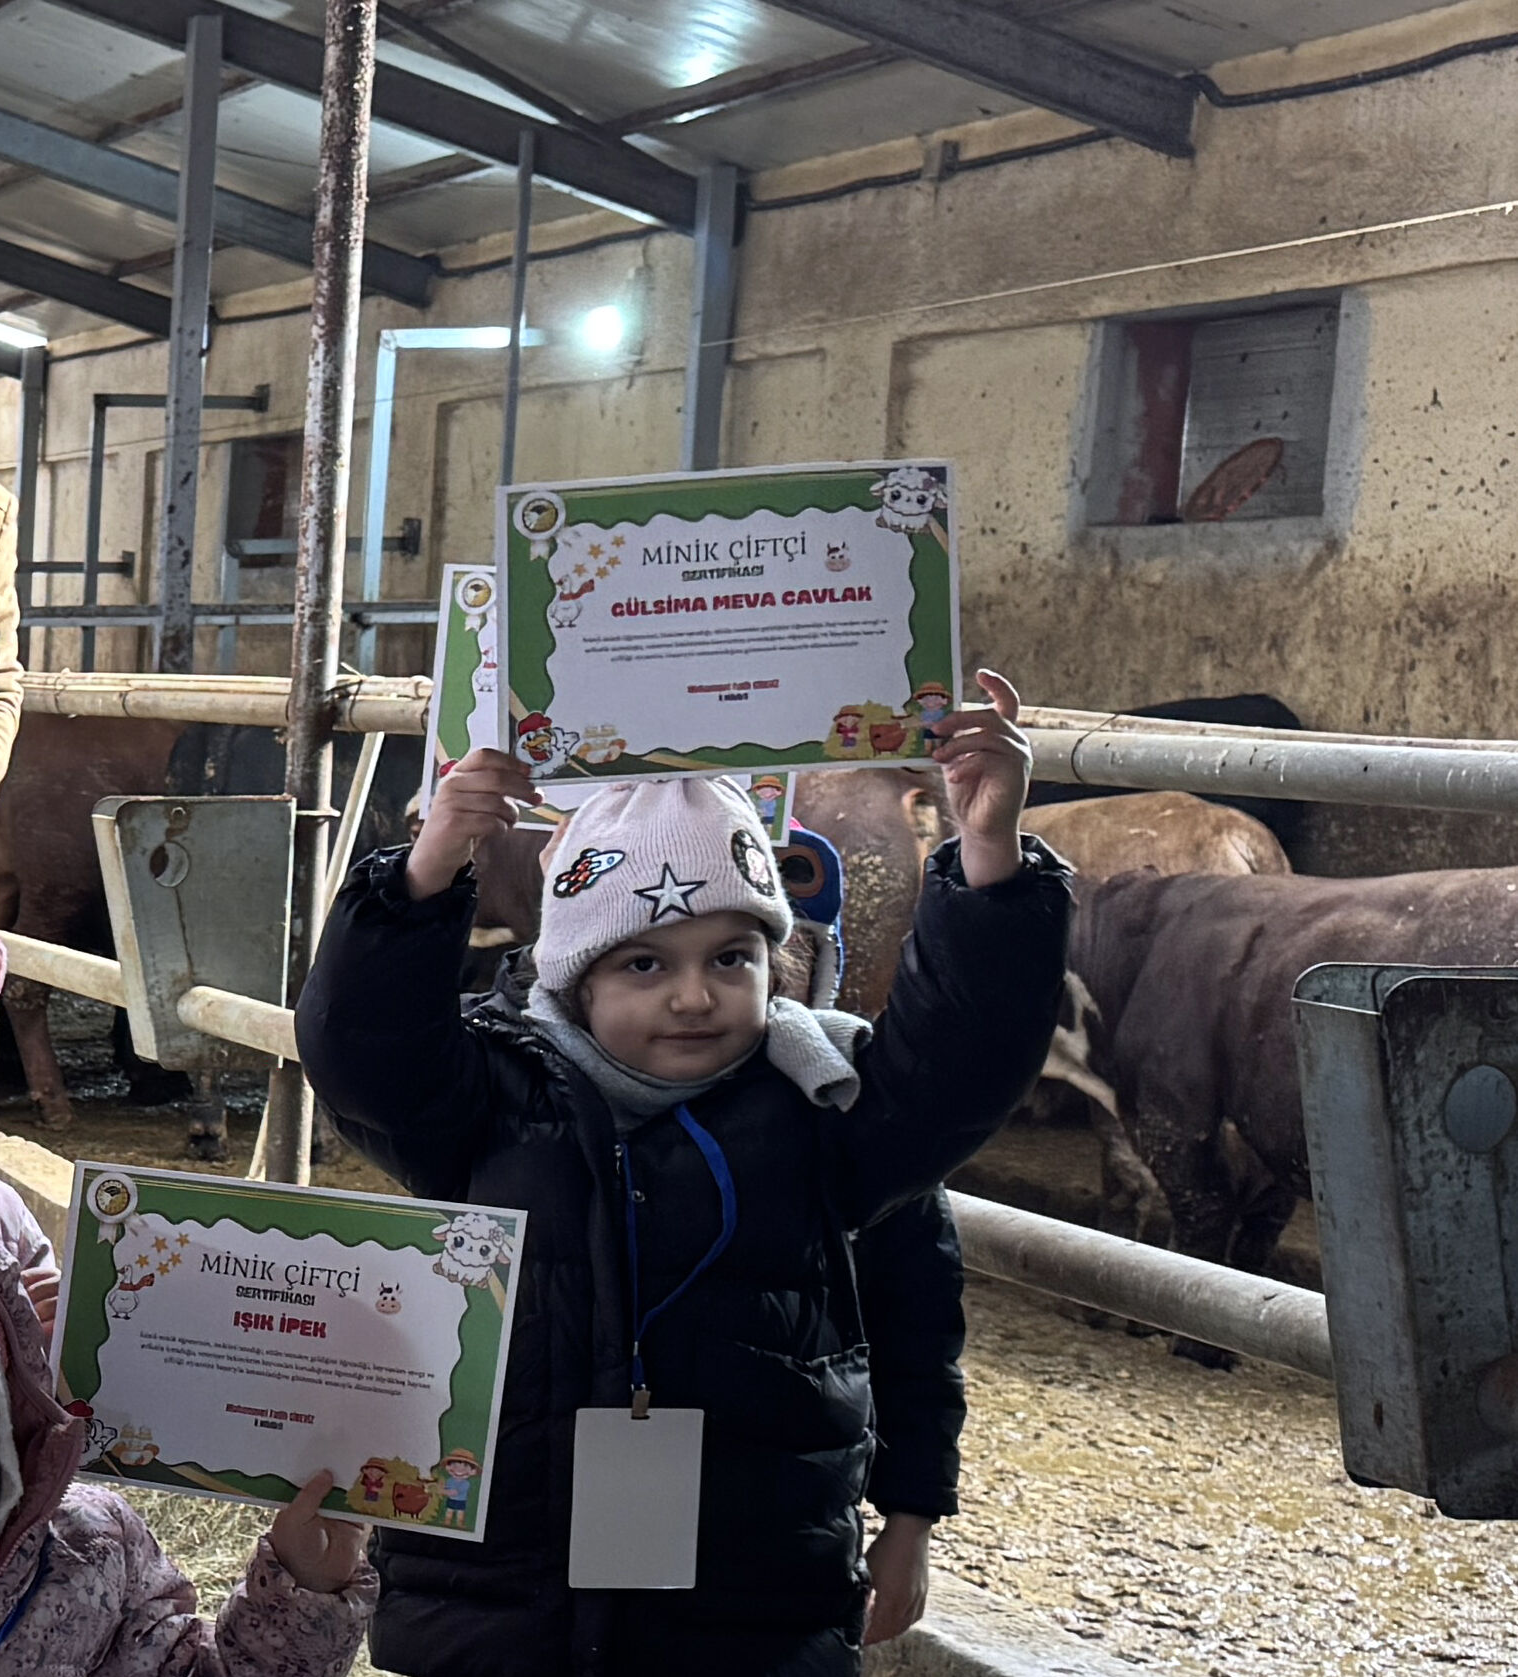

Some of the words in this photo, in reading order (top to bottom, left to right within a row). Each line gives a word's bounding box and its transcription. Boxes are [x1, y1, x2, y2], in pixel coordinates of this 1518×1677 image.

[642, 538, 719, 566] MİNİK
[728, 531, 807, 568] ÇİFTÇİ
[611, 594, 708, 618] GÜLSİMA
[712, 591, 776, 611] MEVA
[781, 585, 872, 606] CAVLAK
[200, 1250, 276, 1281] MİNİK
[284, 1260, 361, 1297] ÇİFTÇİ
[233, 1311, 274, 1332] IŞIK
[279, 1312, 327, 1339] İPEK
